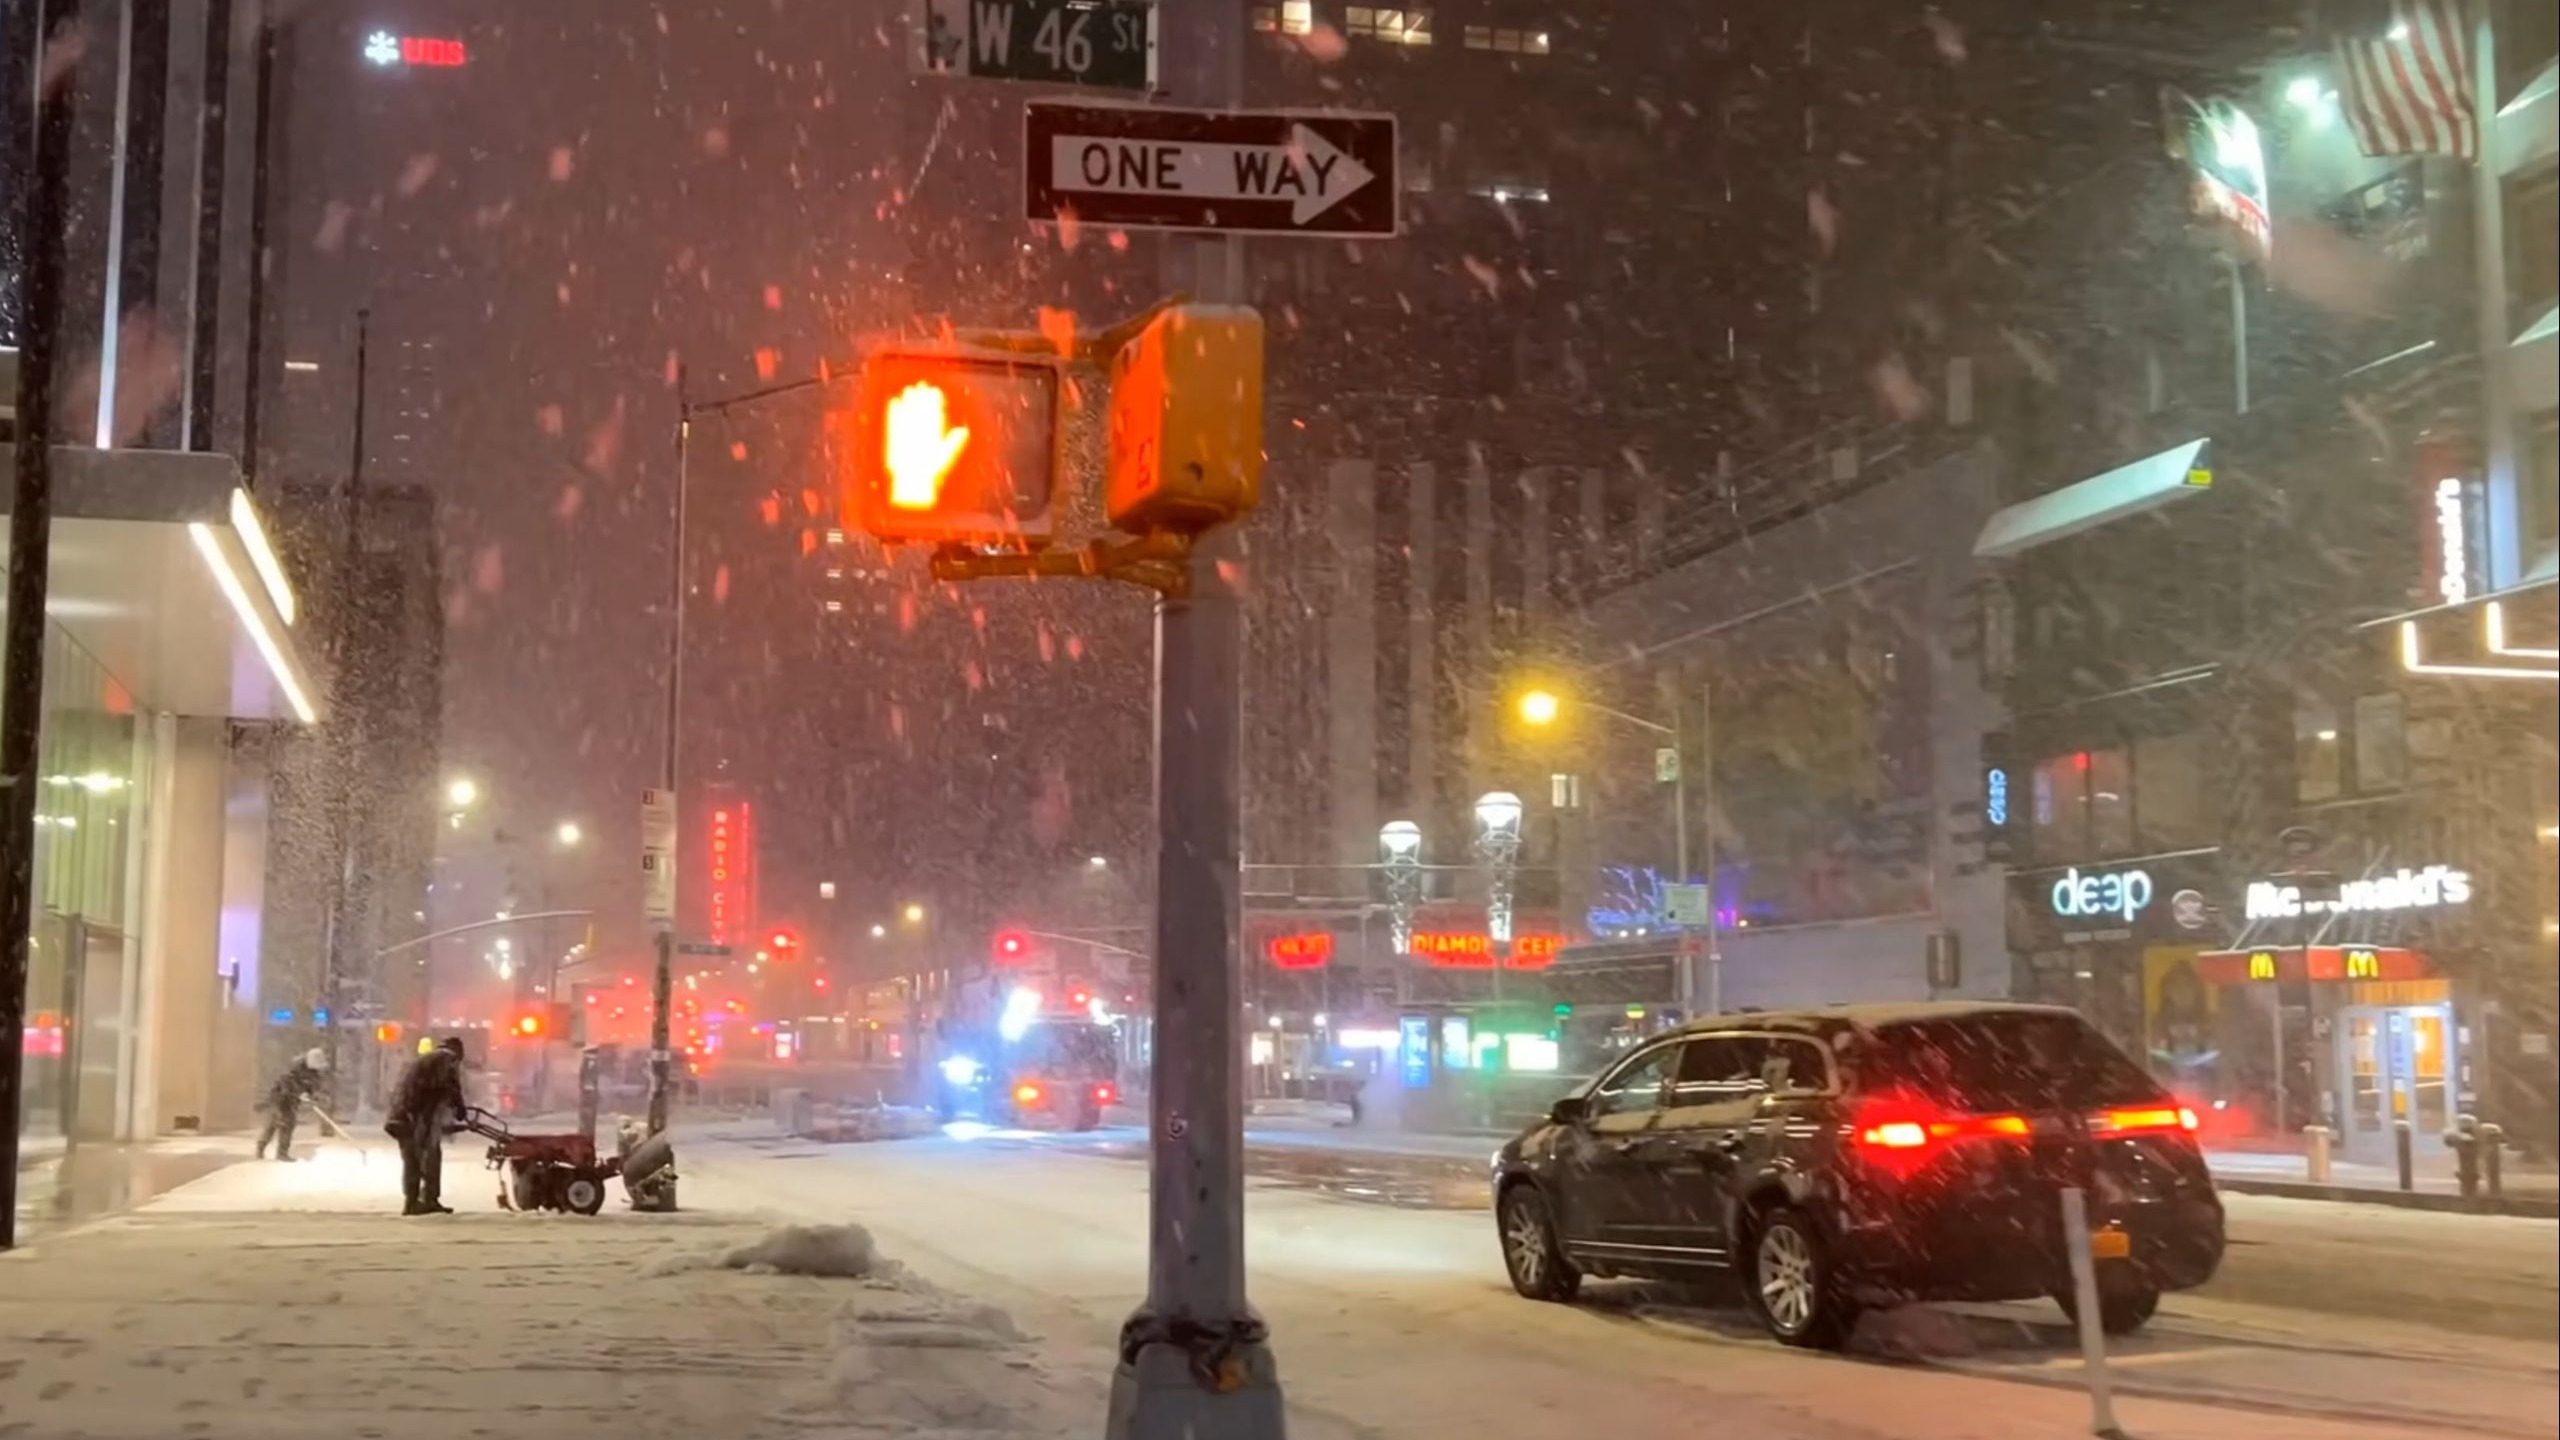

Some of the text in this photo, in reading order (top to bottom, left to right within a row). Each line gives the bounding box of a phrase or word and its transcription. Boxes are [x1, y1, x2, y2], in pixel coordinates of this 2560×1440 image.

[974, 1, 1141, 73] W 46 St
[1081, 142, 1338, 197] ONE WAY
[712, 810, 728, 881] RADIO
[2052, 867, 2153, 922] deep
